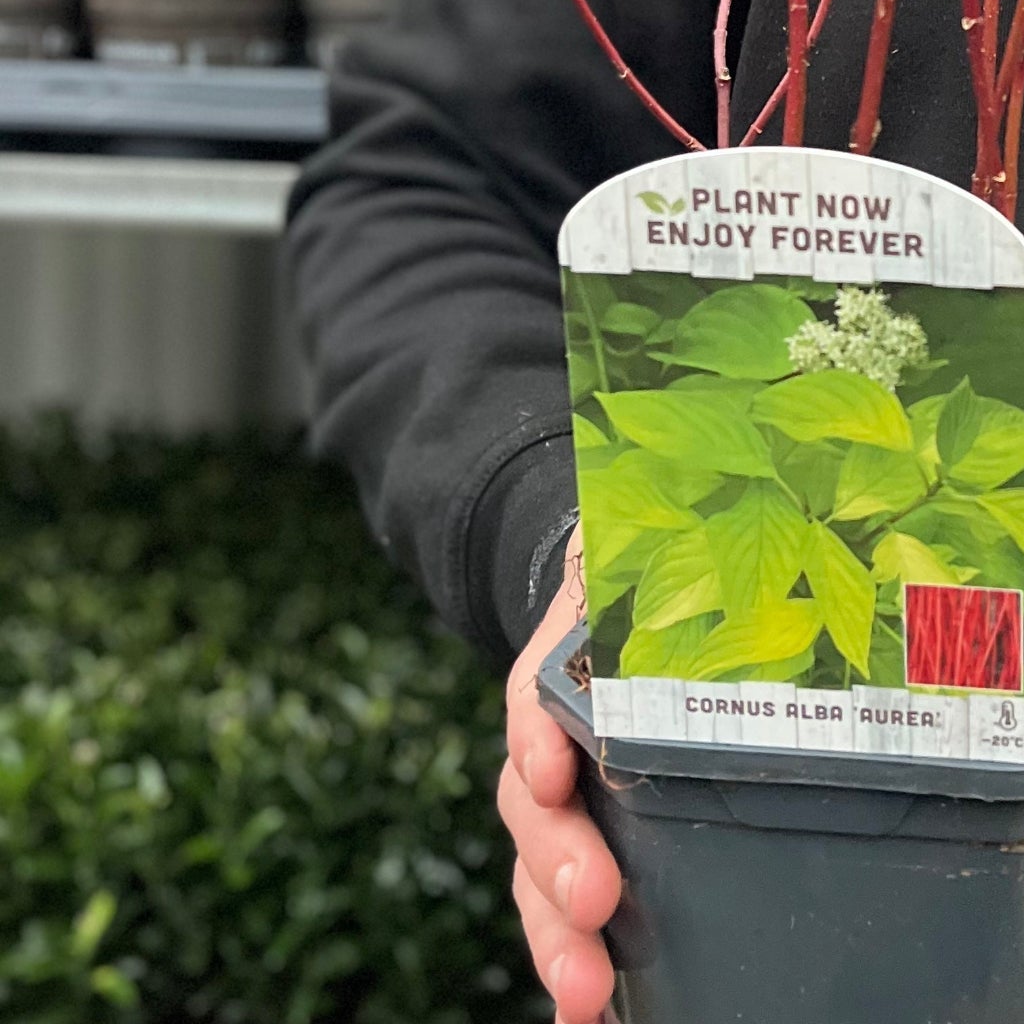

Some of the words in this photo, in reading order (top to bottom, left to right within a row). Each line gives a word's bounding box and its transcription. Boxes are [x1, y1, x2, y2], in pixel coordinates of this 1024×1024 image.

[692, 187, 802, 217] PLANT
[817, 193, 892, 221] NOW
[647, 220, 756, 249] ENJOY
[771, 225, 925, 258] FOREVER
[685, 696, 777, 718] CORNUS
[785, 702, 844, 722] ALBA
